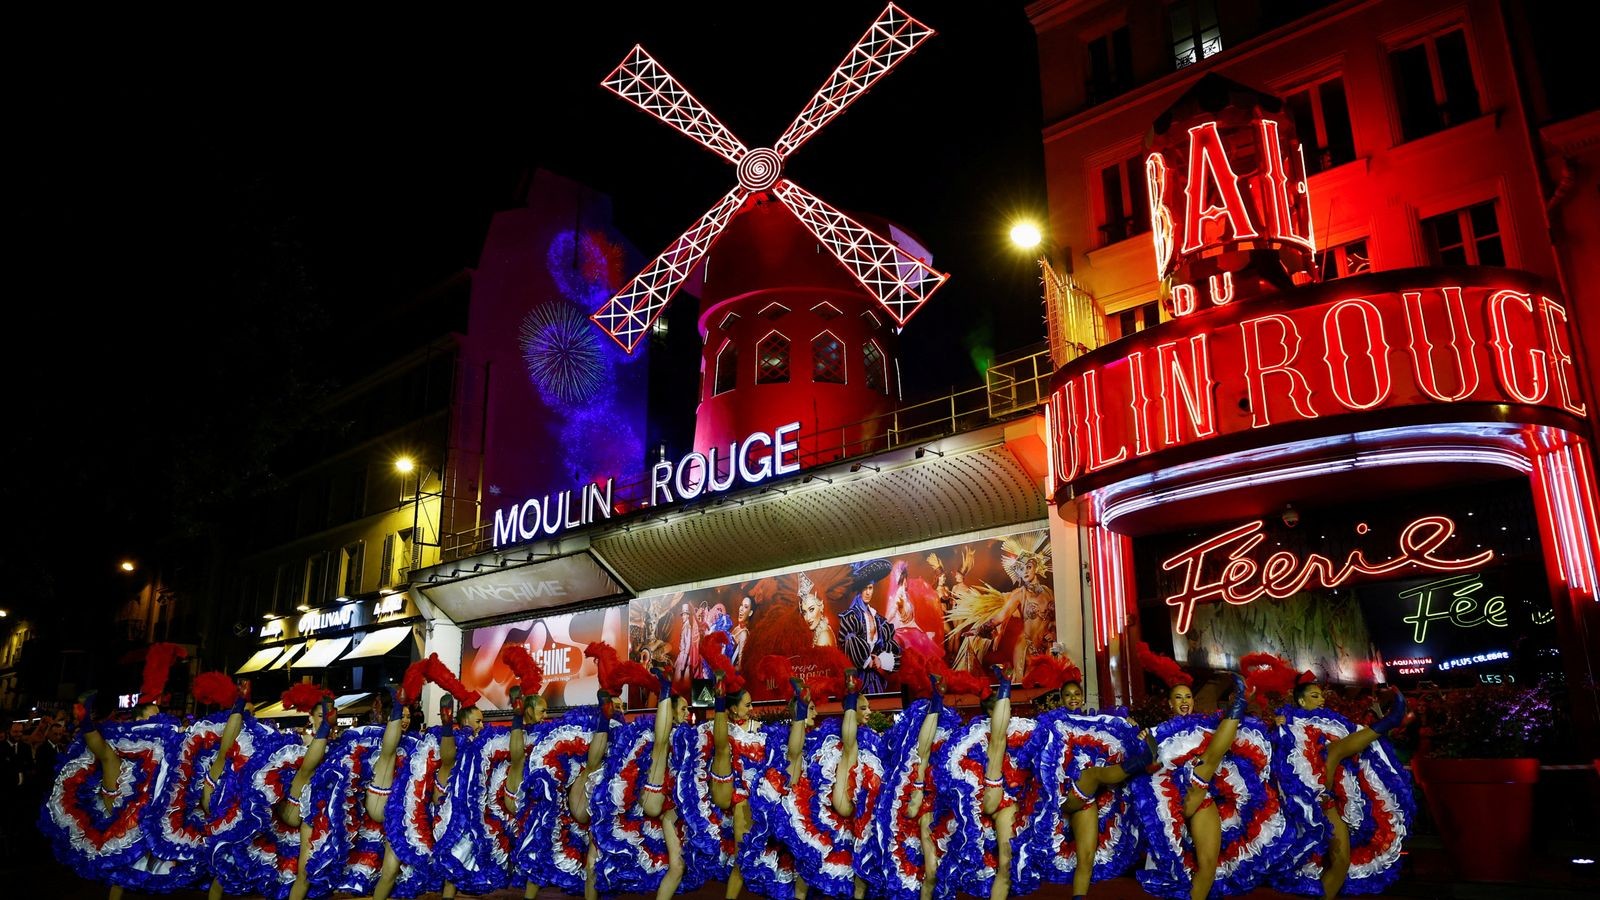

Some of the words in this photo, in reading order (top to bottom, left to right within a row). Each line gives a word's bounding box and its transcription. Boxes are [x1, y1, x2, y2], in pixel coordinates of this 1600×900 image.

[1145, 119, 1316, 282] BAL
[1172, 271, 1234, 317] DU
[1045, 333, 1215, 496] ULIN
[1239, 286, 1587, 430] ROUGE
[493, 477, 613, 548] MOULIN
[651, 421, 801, 507] ROUGE
[1162, 515, 1494, 635] Féerie
[1398, 573, 1509, 644] Fée
[531, 643, 572, 676] CHINE
[1438, 661, 1450, 671] LE
[1450, 657, 1472, 668] PLUS
[1479, 674, 1502, 684] LES
